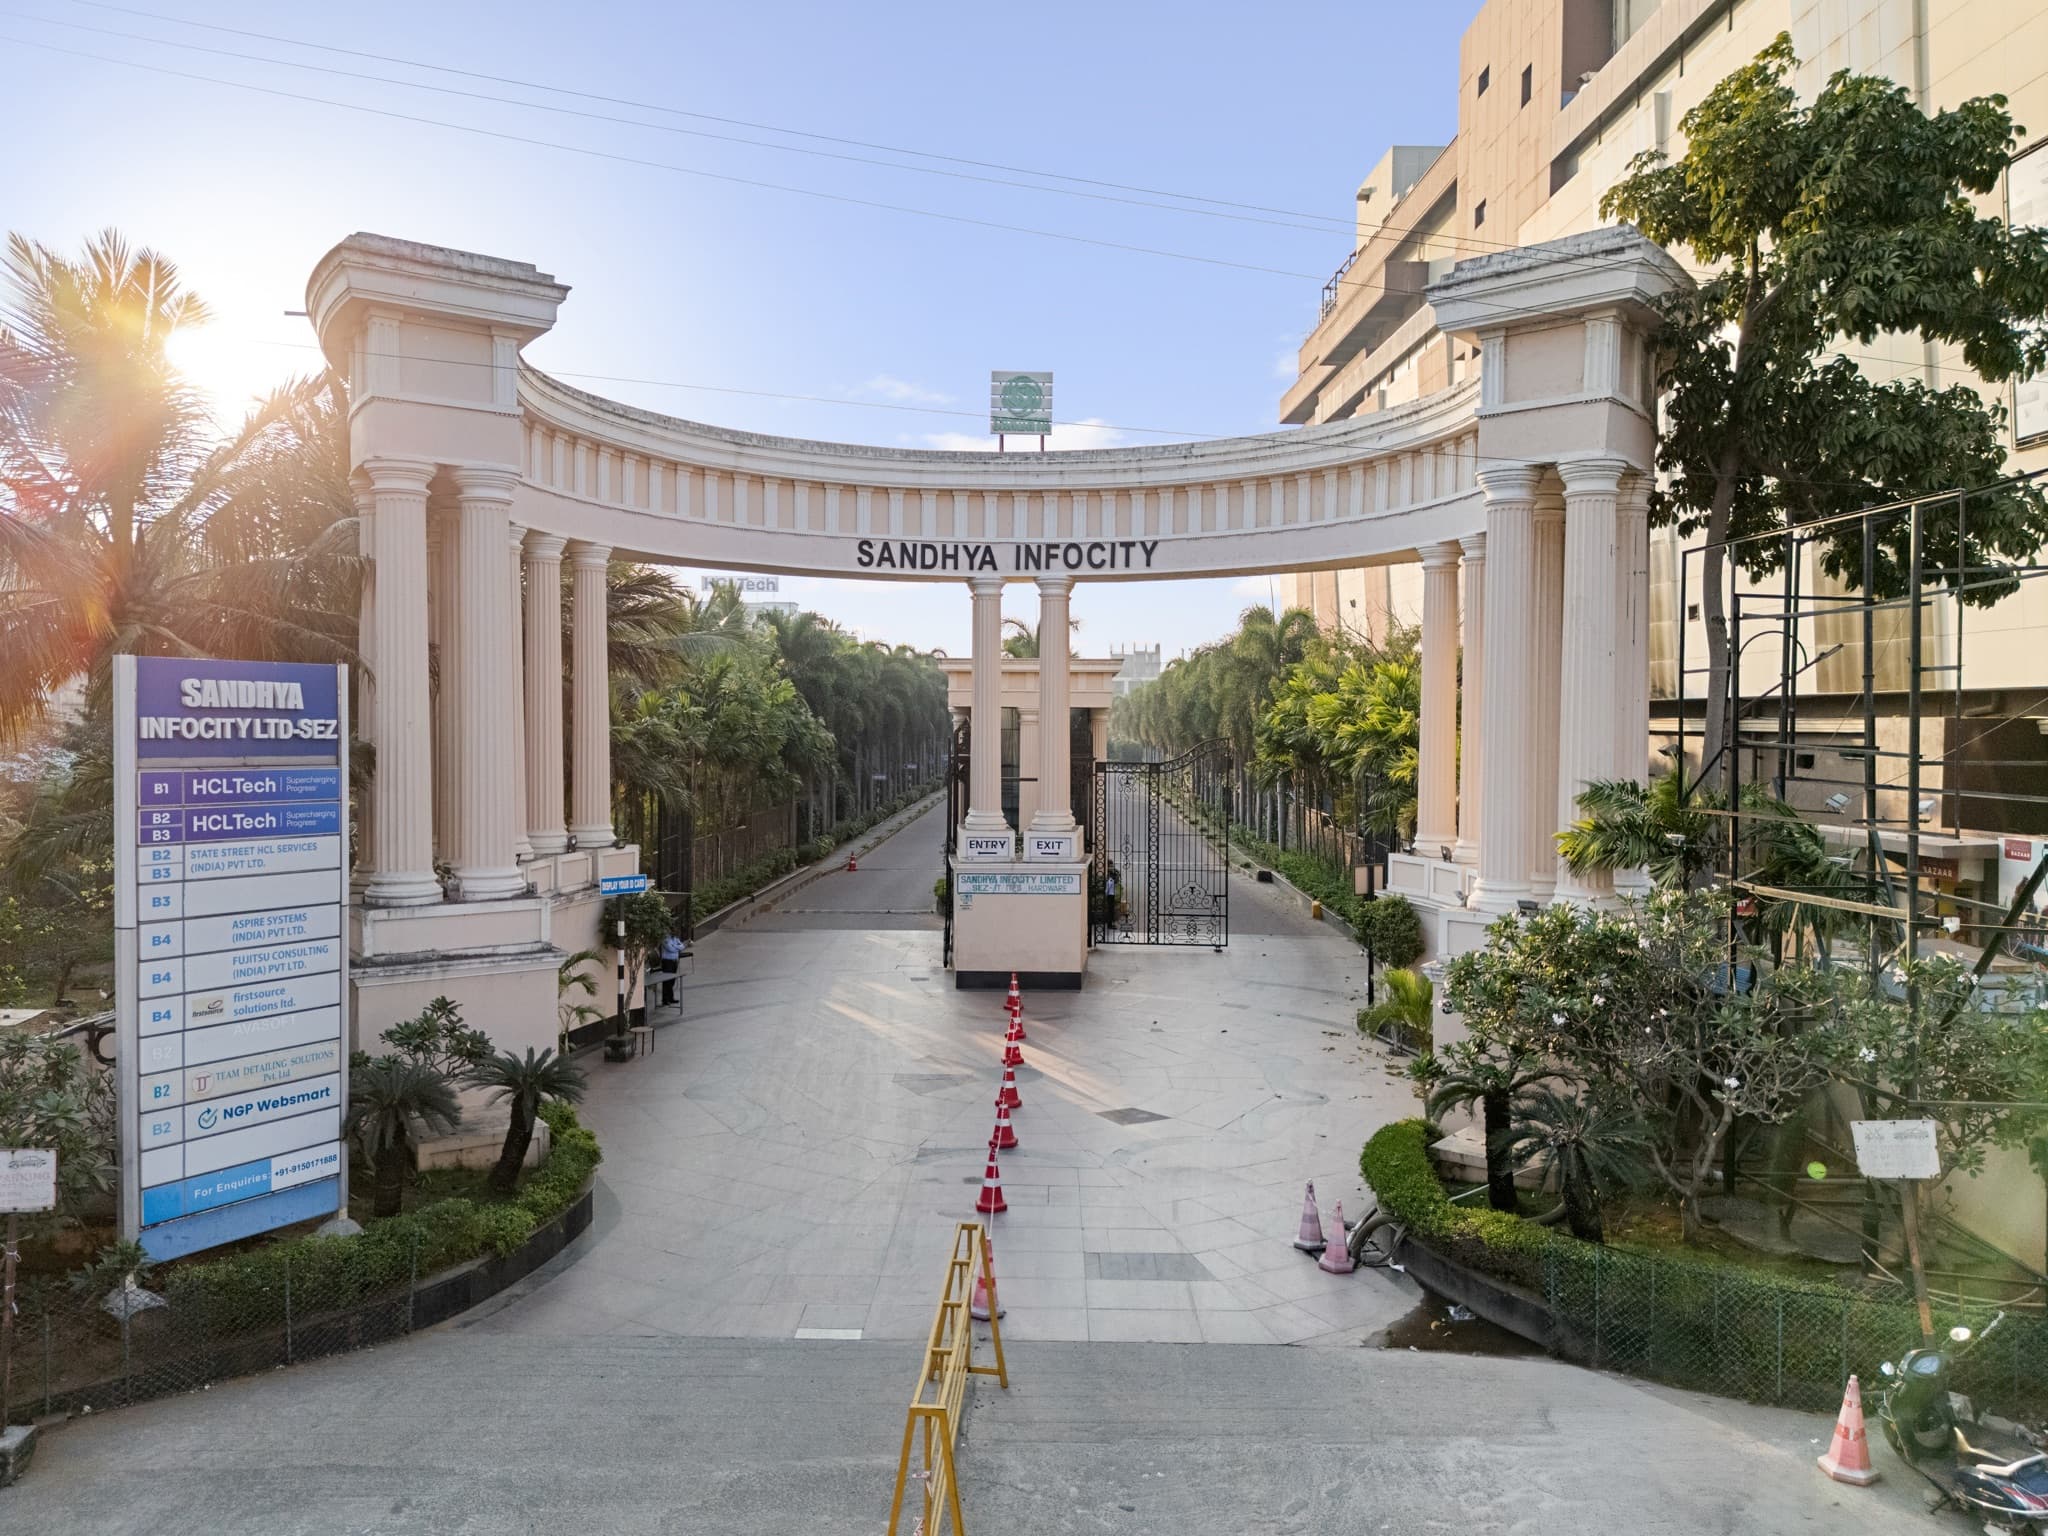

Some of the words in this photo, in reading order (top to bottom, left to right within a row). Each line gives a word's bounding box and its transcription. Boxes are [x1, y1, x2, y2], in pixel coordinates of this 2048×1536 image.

[857, 540, 999, 571] SANDHYA
[1015, 541, 1159, 571] INFOCITY
[181, 678, 304, 710] SANDHYA
[140, 717, 252, 739] INFOCITY
[253, 719, 338, 739] LTD-SEZ
[193, 778, 276, 795] HCLTech
[286, 776, 336, 785] Supercharging
[154, 783, 169, 794] B1
[152, 813, 171, 825] B2
[286, 810, 336, 820] Supercharging
[193, 815, 276, 832] HCLTech
[152, 830, 170, 841] B3
[190, 850, 219, 860] STATE
[221, 848, 254, 858] STREET
[257, 846, 275, 855] HCL
[277, 842, 318, 854] SERVICES
[969, 840, 1007, 849] ENTRY
[1037, 841, 1063, 850] EXIT
[152, 850, 171, 861] B2
[191, 861, 225, 873] (INDIA)
[227, 859, 245, 870] PVT
[247, 858, 266, 868] LTD.
[152, 867, 171, 879] B3
[961, 876, 997, 884] SANDHYA
[1040, 875, 1074, 884] LIMITED
[152, 896, 171, 908] B3
[232, 916, 265, 930] ASPIRE
[267, 913, 308, 925] SYSTEMS
[152, 934, 171, 946] B4
[232, 929, 266, 944] (INDIA)
[267, 927, 285, 939] PVT
[287, 925, 306, 936] LTD.
[232, 953, 270, 966] FUJITSU
[272, 945, 329, 961] CONSULTING
[232, 966, 267, 980] (INDIA)
[268, 963, 285, 975] PVT
[287, 960, 307, 971] LTD.
[152, 972, 171, 984] B4
[233, 987, 286, 1003] firstsource
[233, 1002, 279, 1017] solutions
[280, 998, 296, 1009] ltd.
[152, 1010, 172, 1022] B4
[216, 1069, 240, 1081] TEAM
[243, 1060, 287, 1075] DETAILING
[290, 1050, 334, 1066] SOLUTIONS
[154, 1084, 170, 1098] B2
[223, 1104, 253, 1120] NGP
[257, 1086, 331, 1112] Websmart
[152, 1122, 172, 1136] B2
[194, 1187, 213, 1199] For
[216, 1173, 271, 1194] Enquiries:
